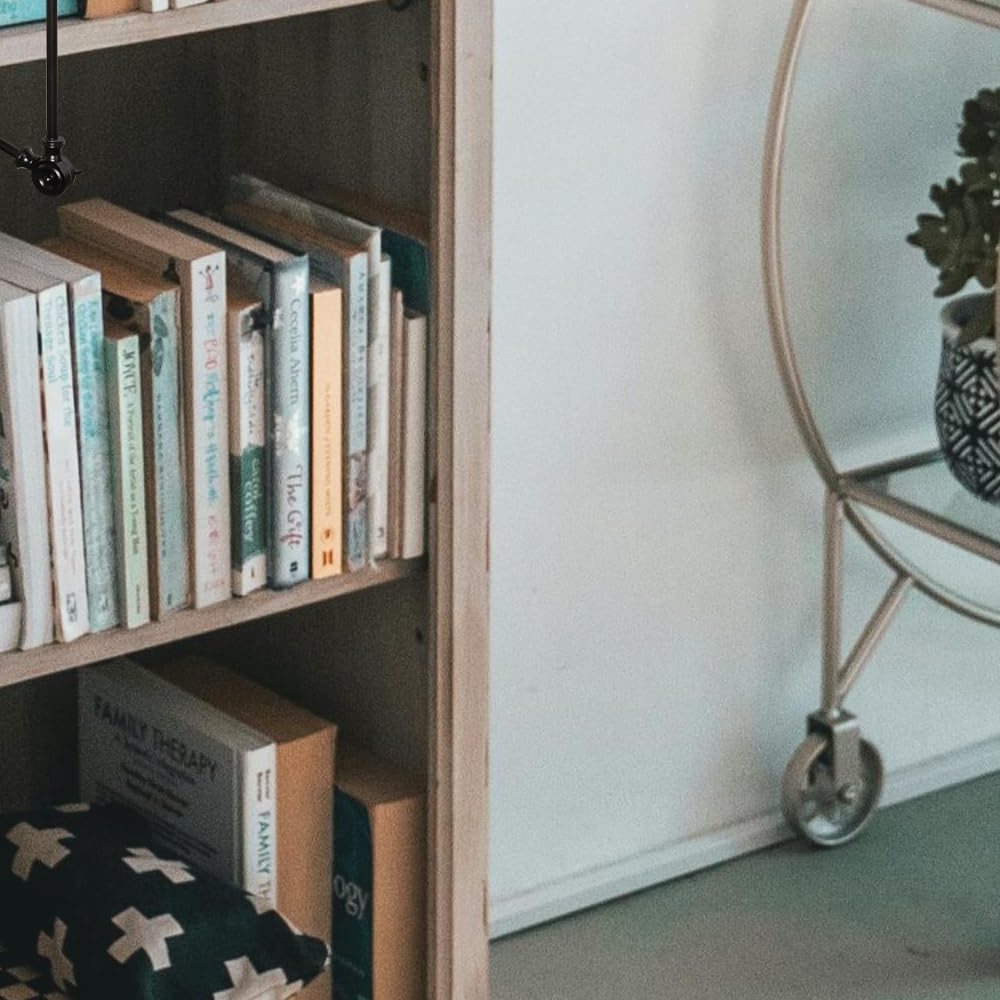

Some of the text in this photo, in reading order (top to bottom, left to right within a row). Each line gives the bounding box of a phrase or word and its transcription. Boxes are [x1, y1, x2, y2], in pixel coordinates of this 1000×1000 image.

[289, 298, 301, 406] Cecelia Ahern
[280, 464, 303, 548] The Gift
[94, 695, 219, 782] FAMILY THERAPY
[258, 810, 271, 875] FAMILY
